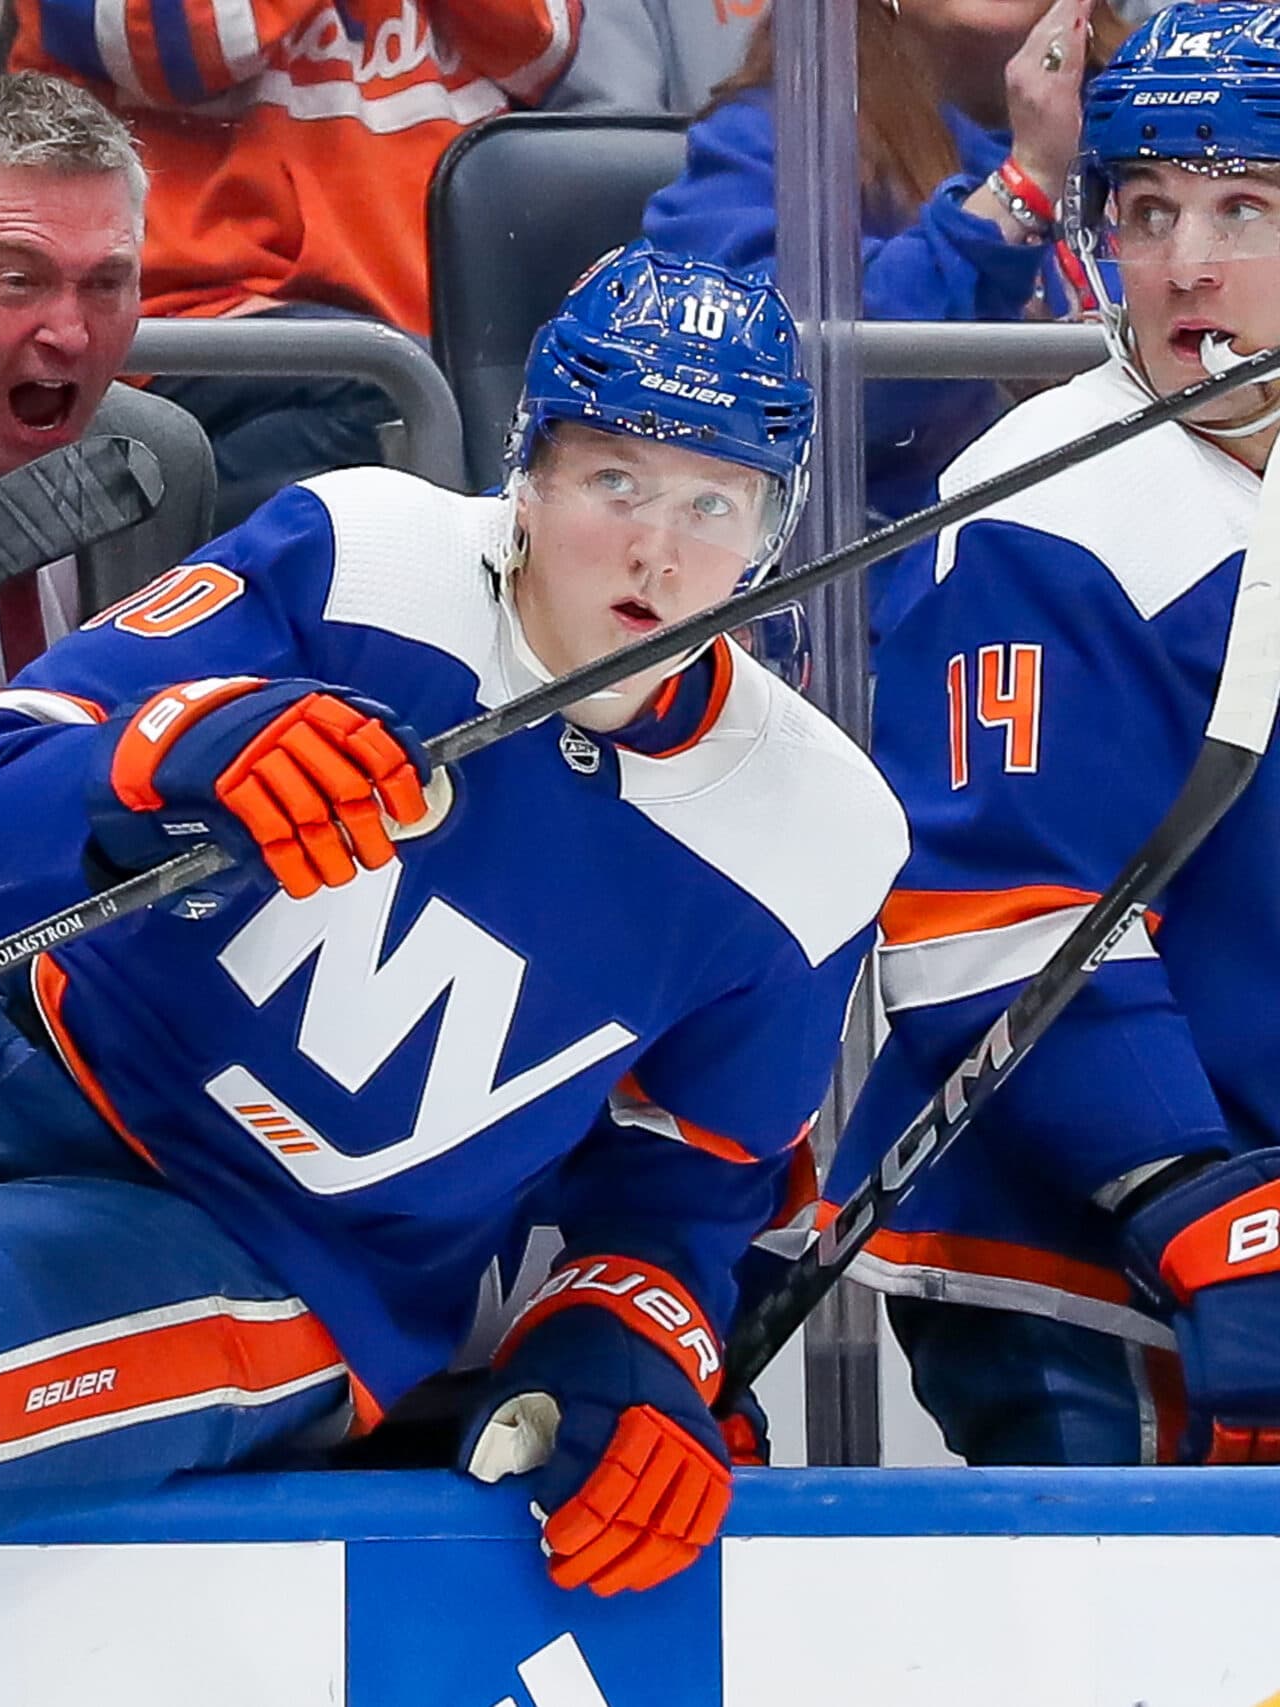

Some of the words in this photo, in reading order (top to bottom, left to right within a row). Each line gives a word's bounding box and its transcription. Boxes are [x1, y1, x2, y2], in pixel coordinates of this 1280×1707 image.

[679, 294, 726, 341] 10
[947, 643, 1043, 791] 14
[525, 1263, 720, 1382] AUER
